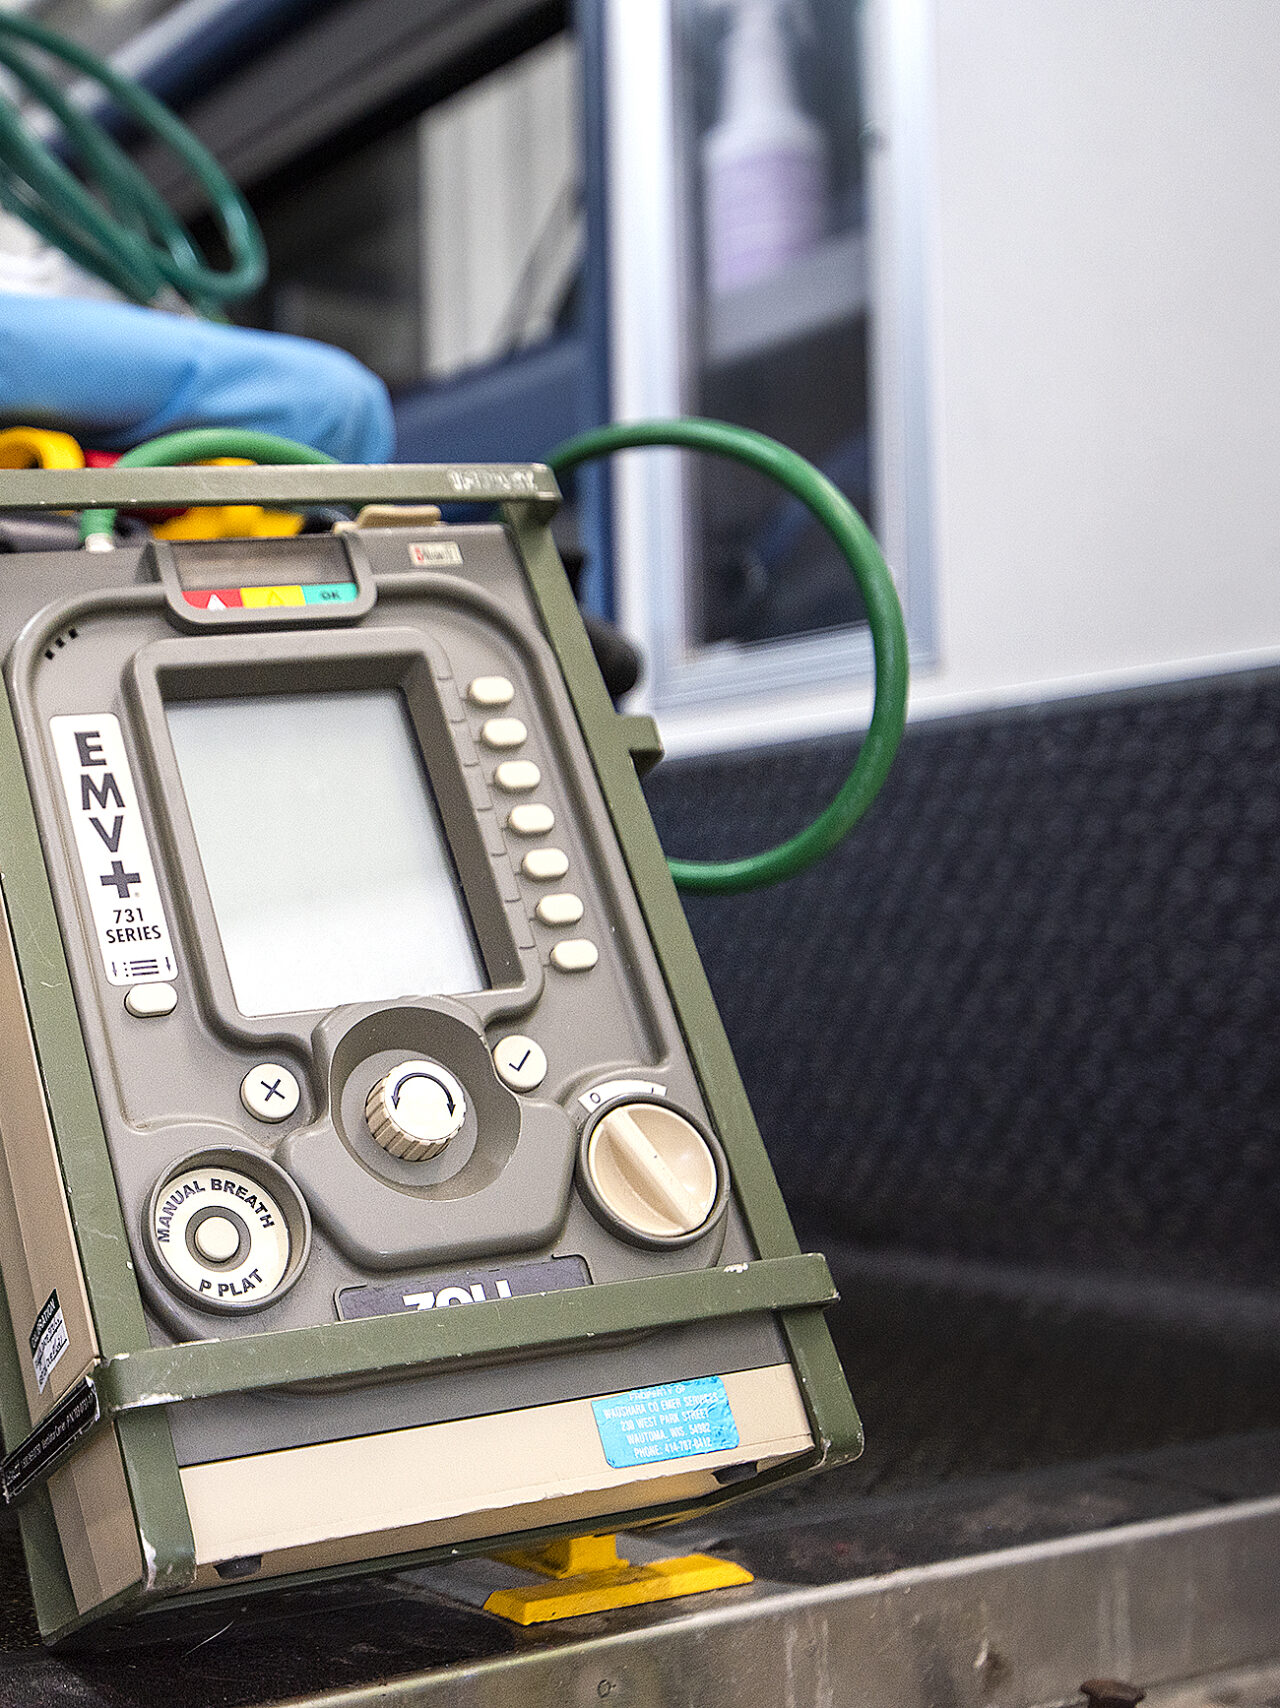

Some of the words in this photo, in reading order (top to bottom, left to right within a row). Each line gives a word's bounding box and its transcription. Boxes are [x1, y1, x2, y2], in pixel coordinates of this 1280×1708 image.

[321, 592, 341, 600] OK
[112, 908, 144, 924] 731
[106, 925, 162, 944] SERIES
[157, 1180, 206, 1243] MANUAL
[210, 1178, 276, 1229] BREATH
[199, 1279, 212, 1293] P
[218, 1268, 263, 1297] PLAT
[628, 1386, 673, 1402] PROPERTY
[674, 1384, 686, 1395] OF
[603, 1404, 647, 1420] WAUSHARA
[647, 1401, 660, 1413] CO
[661, 1398, 682, 1411] EMER
[683, 1392, 720, 1408] SERVICES
[636, 1416, 659, 1429] WEST
[660, 1413, 681, 1425] PARK
[681, 1407, 710, 1421] STREET
[633, 1444, 664, 1459] PHONE:
